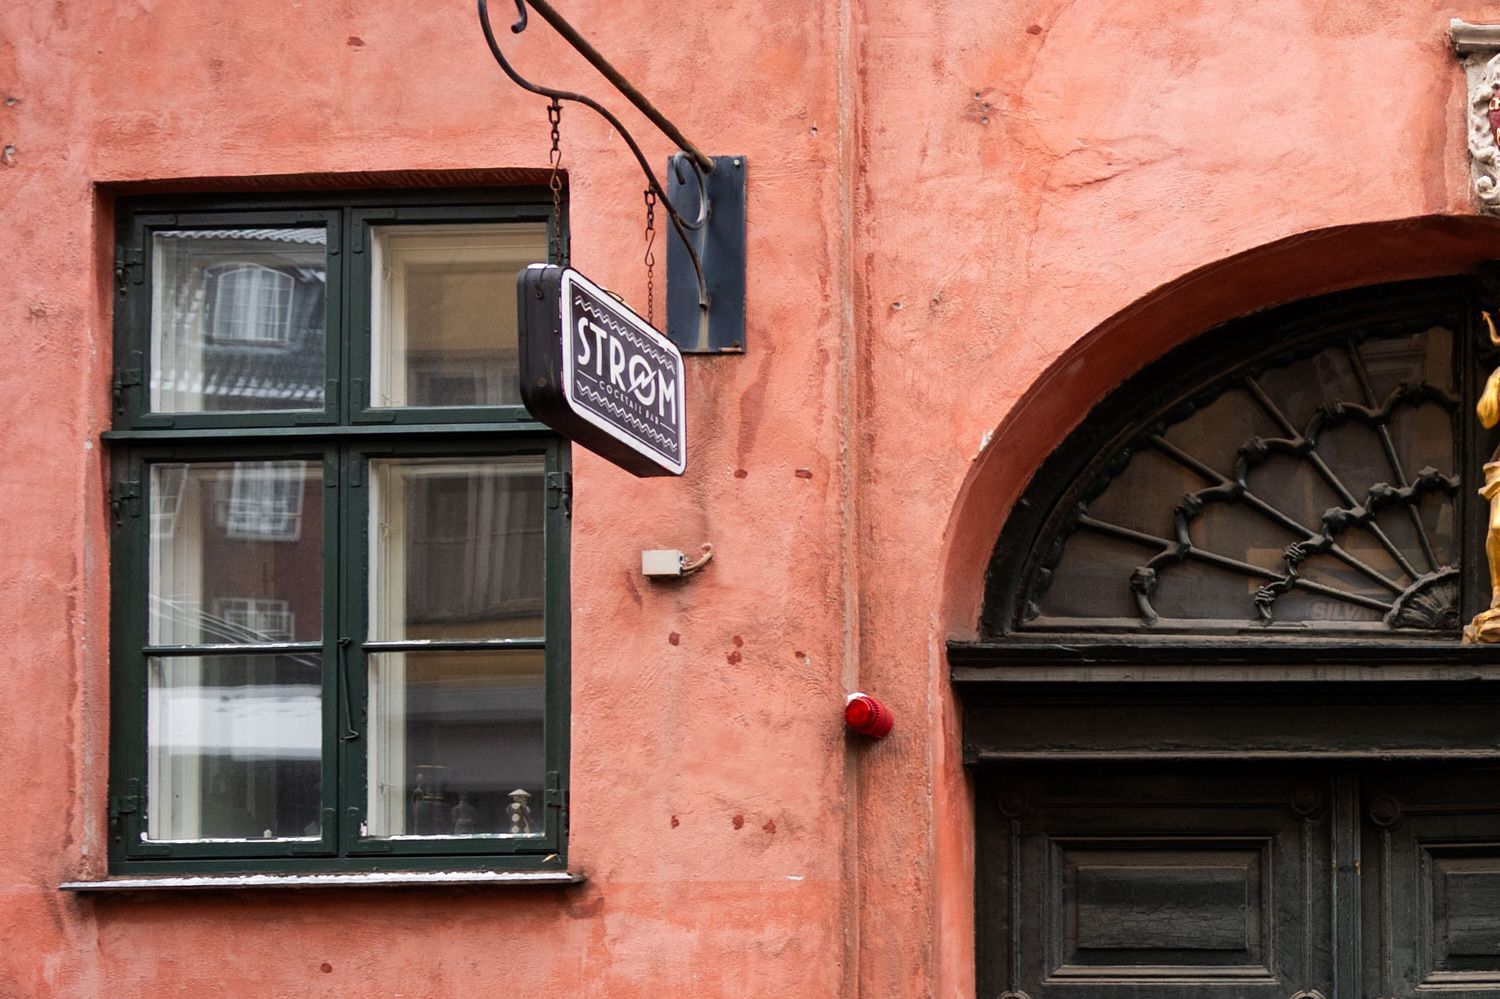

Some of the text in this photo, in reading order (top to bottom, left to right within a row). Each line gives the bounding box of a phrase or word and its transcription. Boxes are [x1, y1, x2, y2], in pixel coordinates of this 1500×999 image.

[577, 317, 676, 425] STRØM
[599, 381, 659, 425] COCKTAIL BAR
